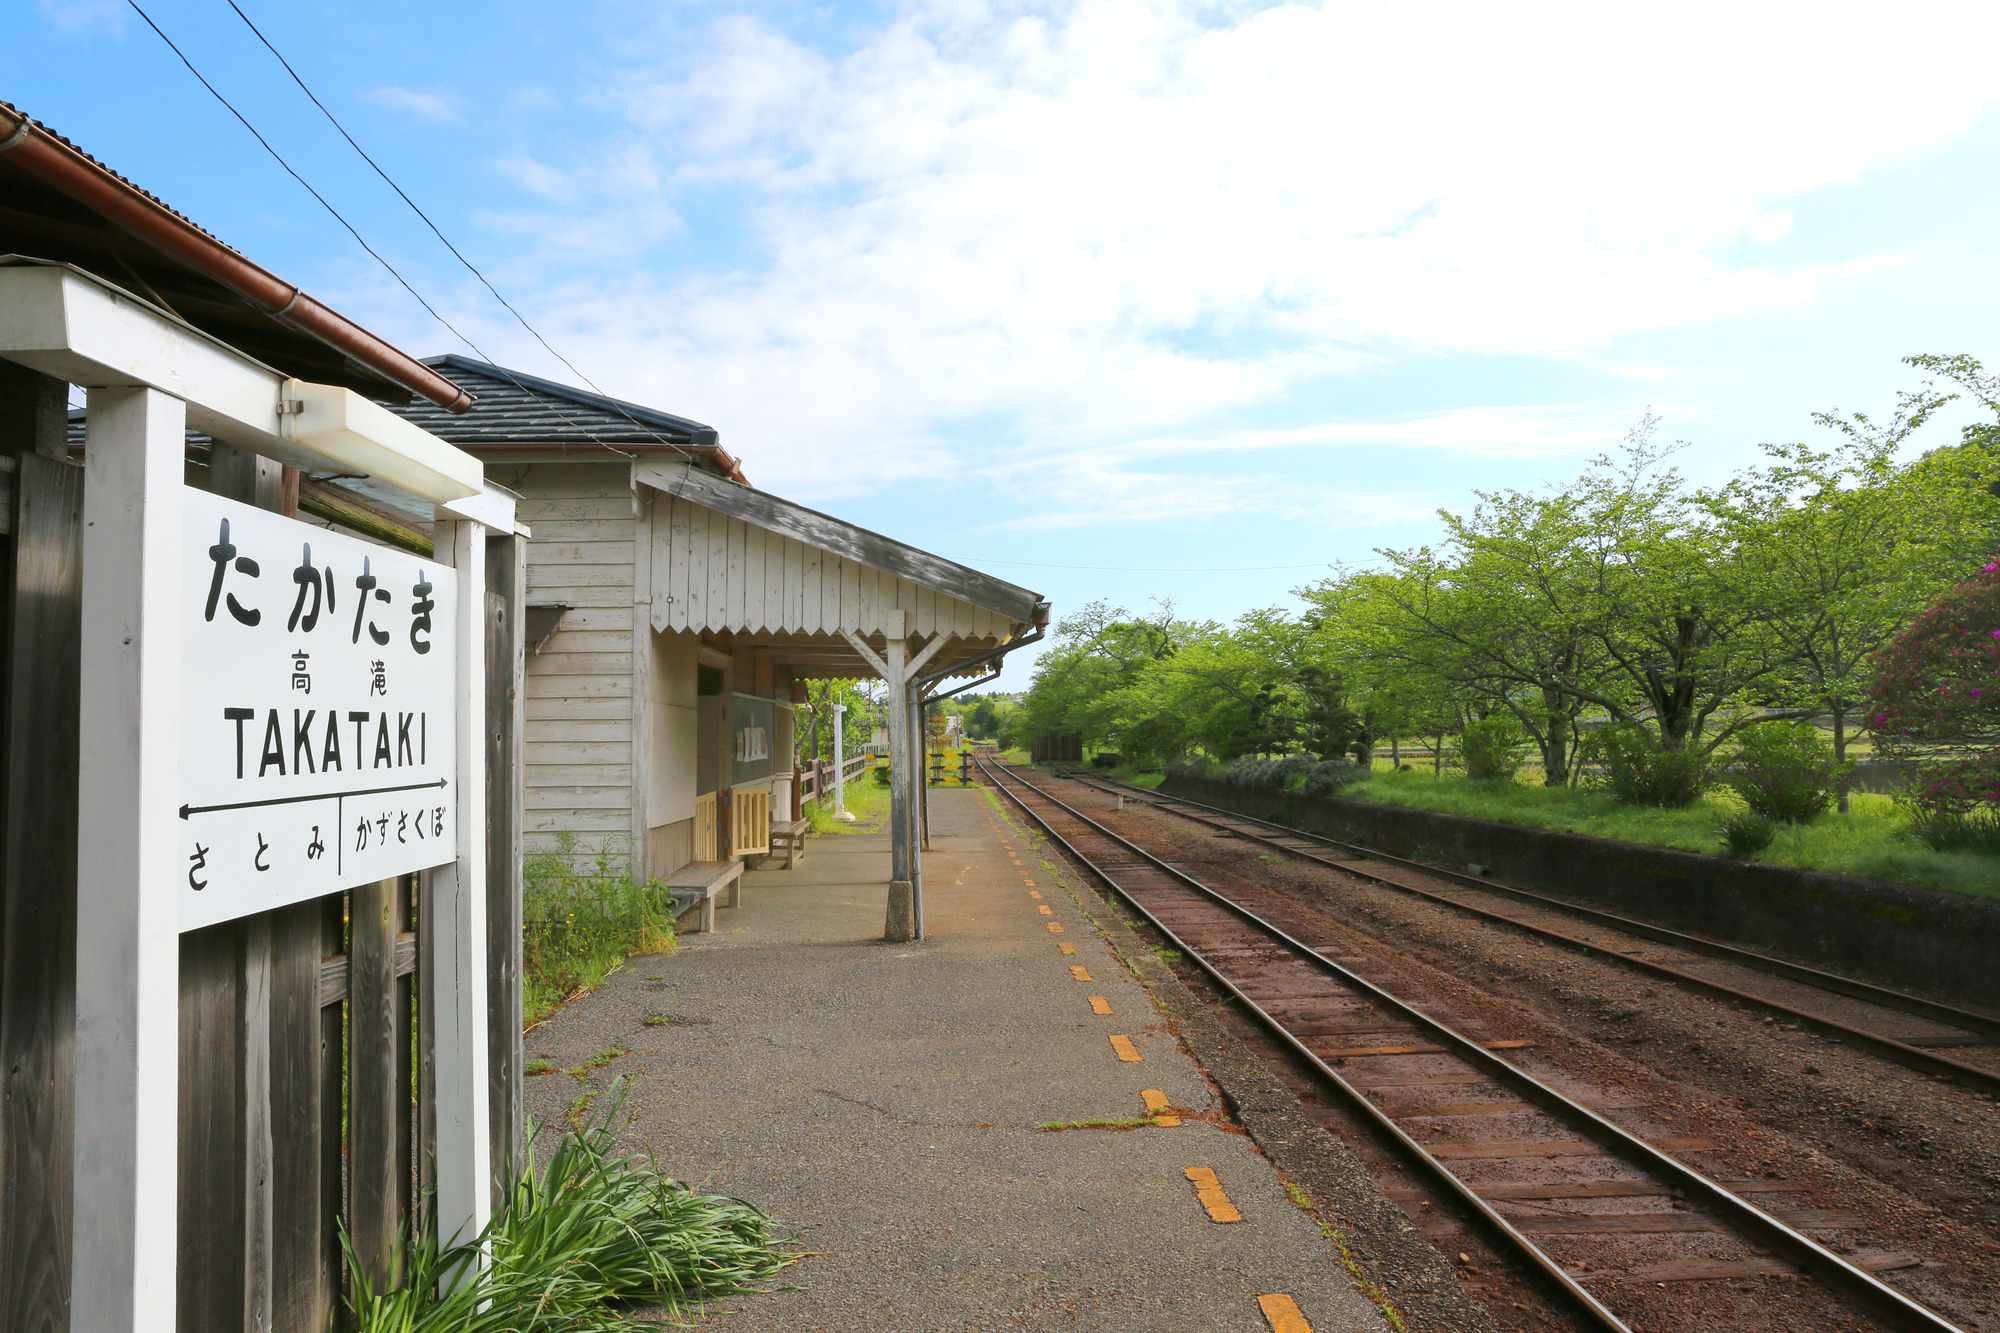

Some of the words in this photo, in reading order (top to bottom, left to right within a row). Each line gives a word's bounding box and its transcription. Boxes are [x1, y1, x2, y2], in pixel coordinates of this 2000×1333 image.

[205, 517, 435, 655] たかたき
[291, 649, 387, 697] 高滝
[224, 708, 426, 779] TAKATAKI
[188, 825, 325, 891] さとみ
[355, 806, 447, 853] かずさくぼ
